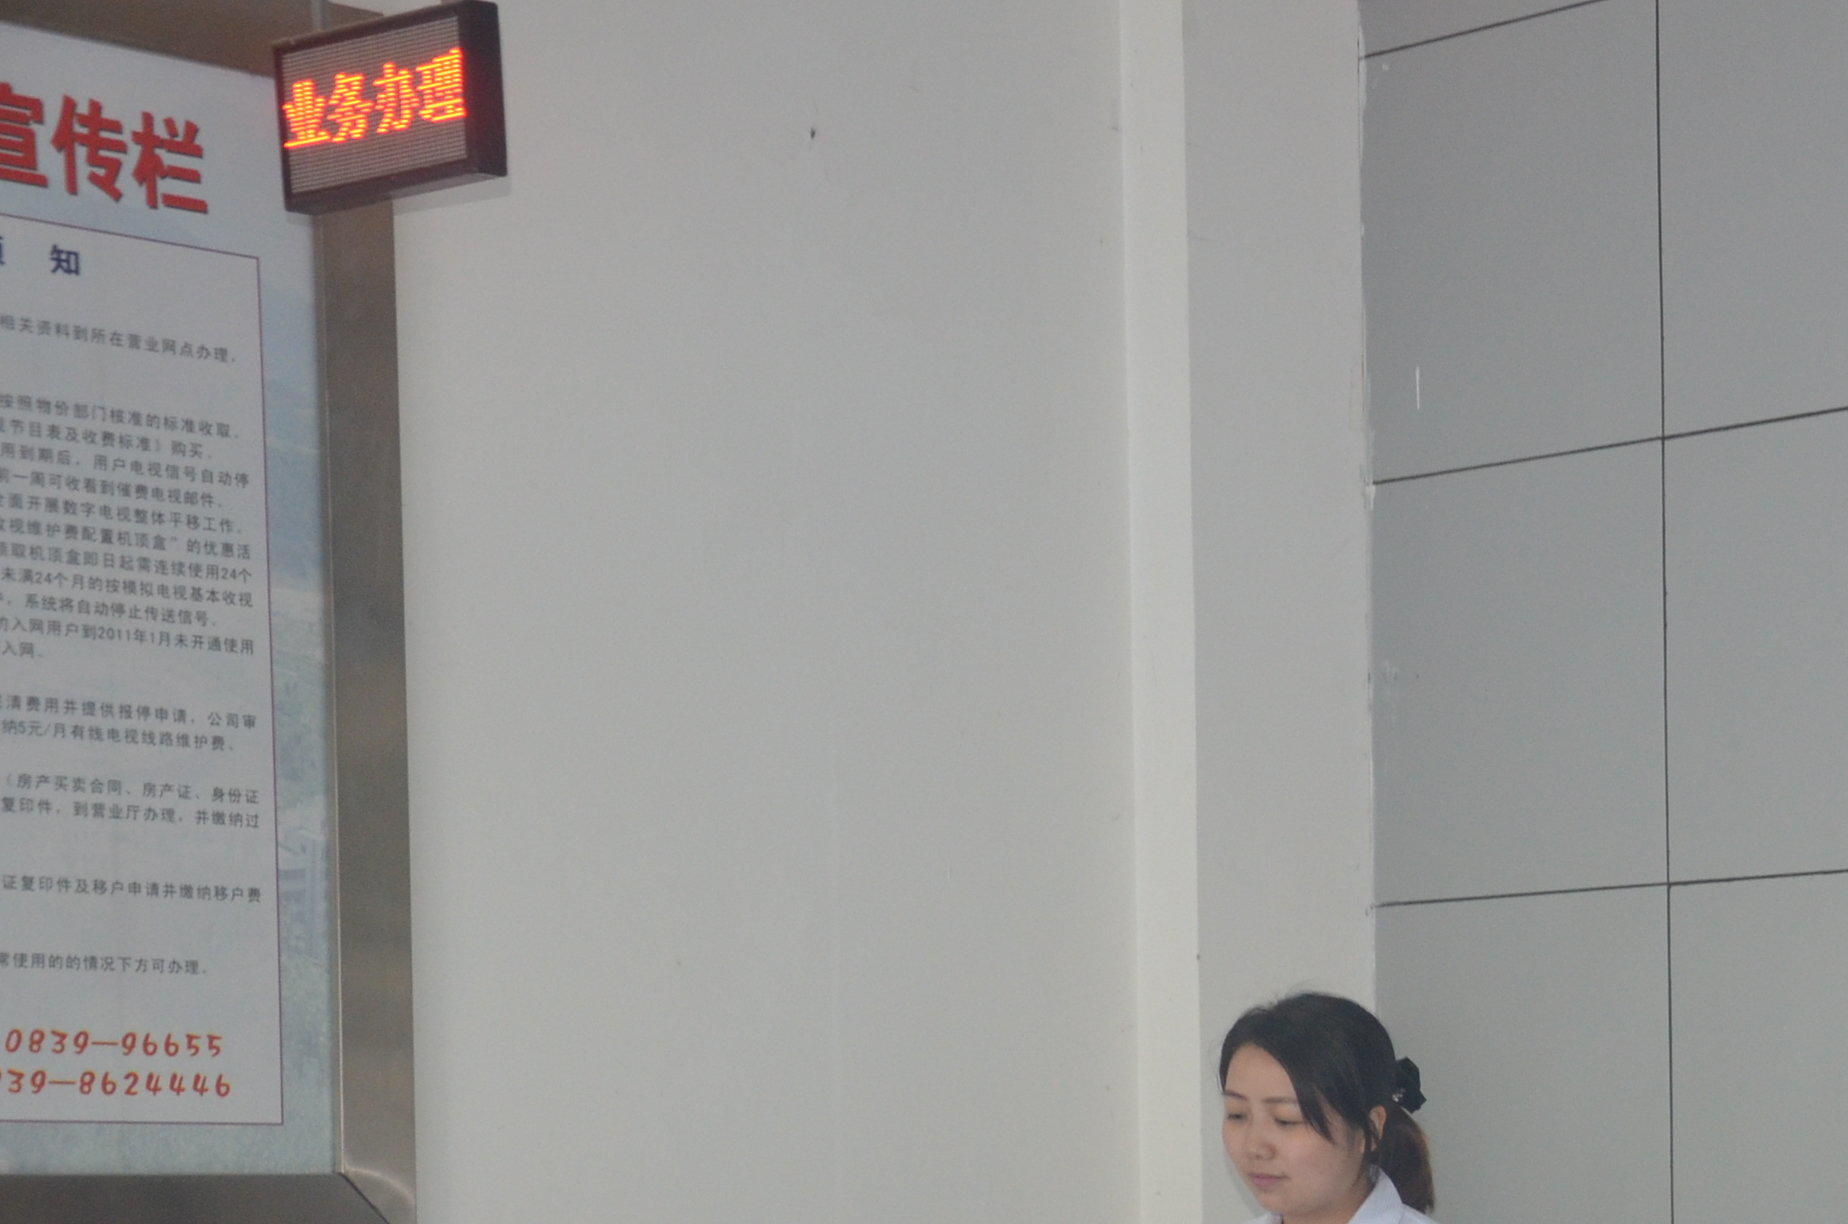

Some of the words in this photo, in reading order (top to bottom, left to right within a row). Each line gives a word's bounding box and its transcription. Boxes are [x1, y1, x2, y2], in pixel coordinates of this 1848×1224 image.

[0, 82, 208, 213] 宣传栏
[283, 47, 467, 149] 业务办理
